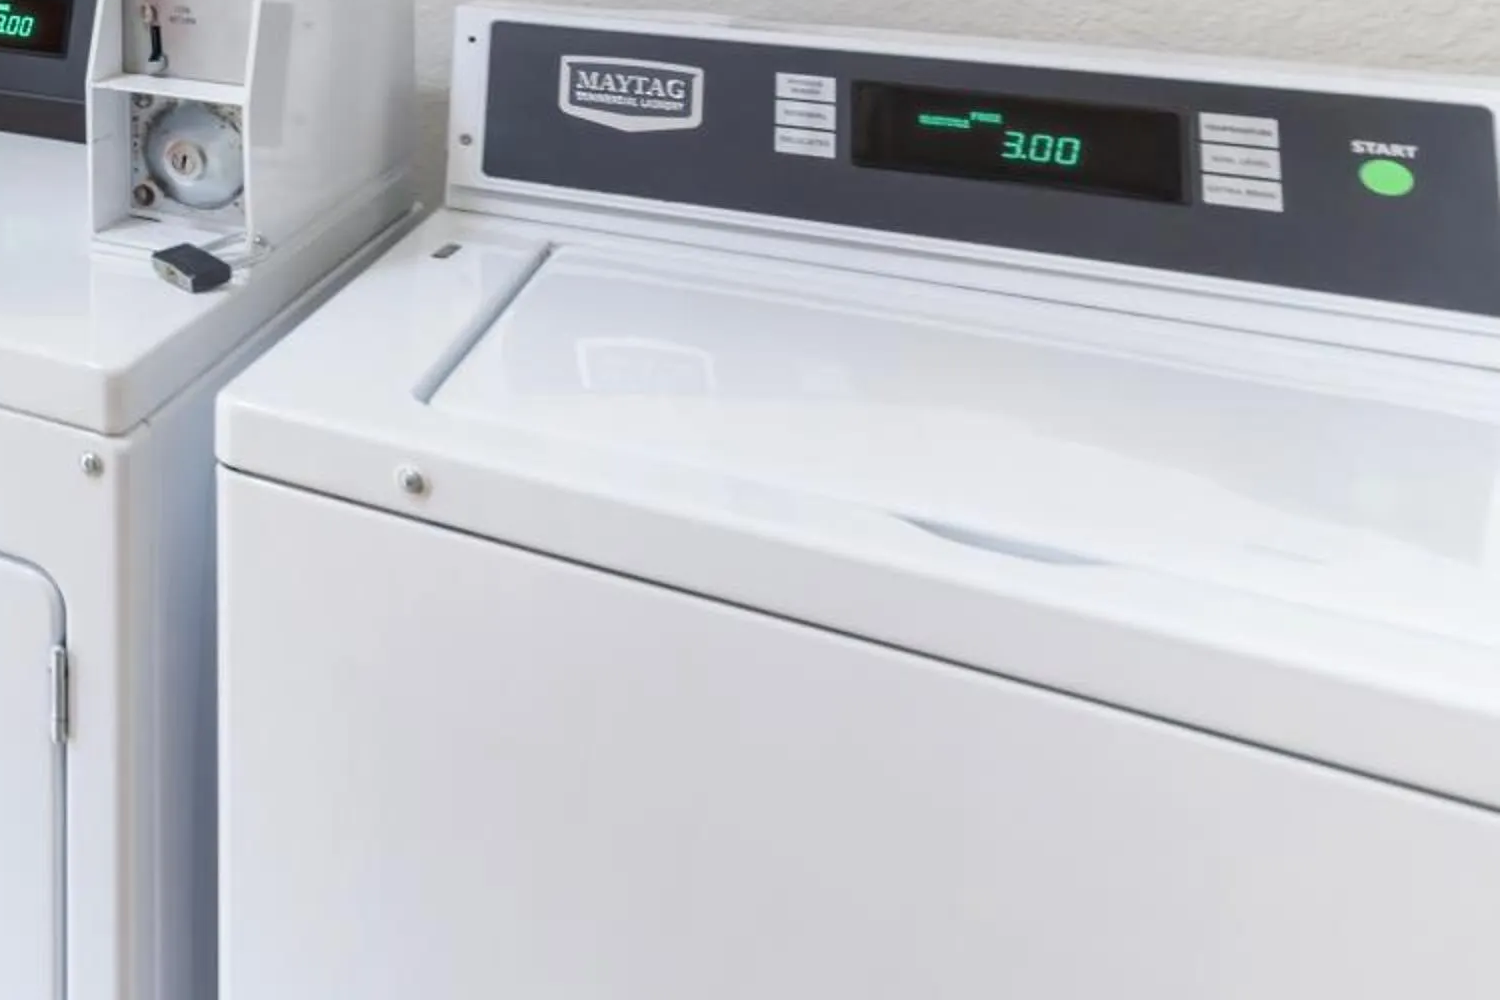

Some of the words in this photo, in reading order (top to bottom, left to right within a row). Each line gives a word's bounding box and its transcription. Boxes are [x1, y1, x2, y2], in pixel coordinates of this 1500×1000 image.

[575, 69, 686, 100] MAYTAG
[1001, 130, 1081, 165] 3.00
[1350, 139, 1419, 159] START
